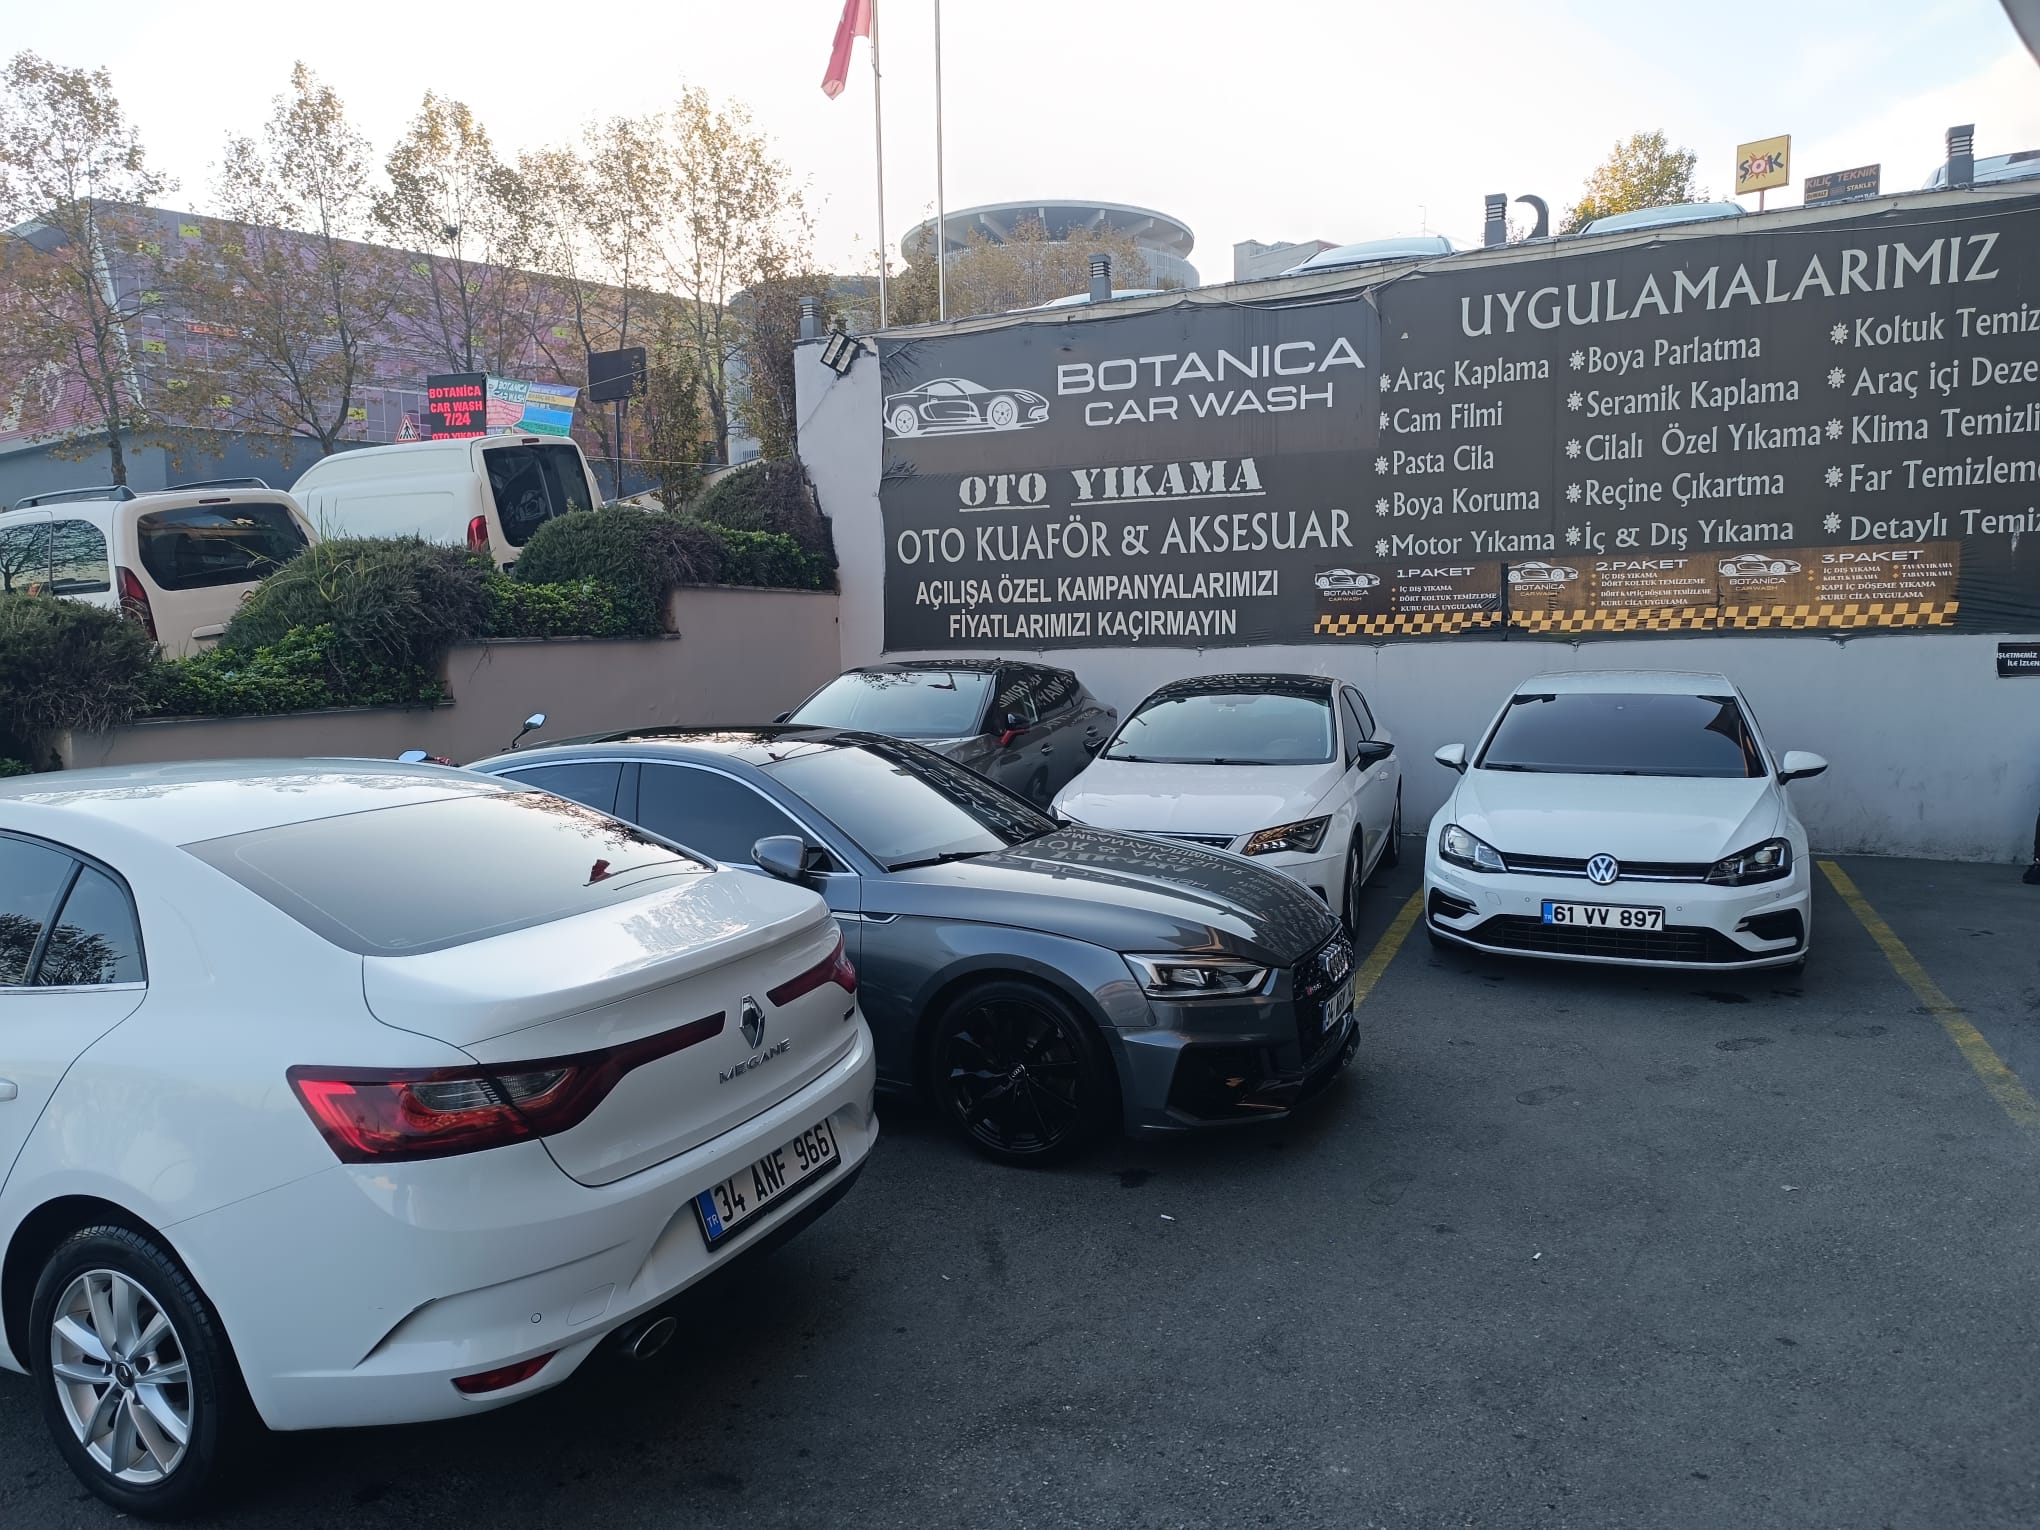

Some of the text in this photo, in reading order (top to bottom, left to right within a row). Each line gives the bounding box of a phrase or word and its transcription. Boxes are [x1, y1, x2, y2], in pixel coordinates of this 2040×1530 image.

[1846, 181, 1876, 192] STANLEY
[1460, 232, 2000, 337] UYGULAMALARIMIZ
[1854, 311, 1945, 347] Koltuk
[1057, 337, 1366, 395] BOTANICA
[1588, 336, 1760, 375] Boya Parlatma
[429, 384, 482, 399] BOTANİCA
[1393, 357, 1549, 395] Araç Kaplama
[1851, 356, 2039, 399] Araç içi Deze
[430, 400, 483, 413] CAR WASH
[1085, 382, 1333, 426] CAR WASH
[1586, 378, 1799, 417] Seramik Kaplama
[443, 412, 471, 426] 7/24
[1393, 400, 1503, 433] Cam Filmi
[1851, 414, 1928, 445] Klima
[1585, 422, 1821, 461] Cilalı Özel Yıkama
[1393, 445, 1494, 475] Pasta Cila
[1850, 455, 2040, 492] Far Temizlem
[959, 458, 1262, 507] OTO YIKAMA
[1585, 472, 1784, 510] Reçine Çıkartma
[1393, 487, 1539, 520] Boya Koruma
[898, 509, 1353, 565] OTO KUAFÖR & AKSESUAR
[1391, 530, 1555, 557] Motor Yıkama
[1584, 519, 1793, 555] İç & Dış Yıkama
[1850, 511, 1948, 543] Detaylı
[1596, 559, 1688, 571] 2.PAKET
[1821, 550, 1924, 564] 3.PAKET
[915, 570, 1278, 610] AÇILIŞA ÖZEL KAMPANYALARIMIZI
[1453, 592, 1497, 600] TEMİZLEME
[1820, 593, 1847, 601] KURU
[1872, 591, 1924, 599] UYGULAMA
[1857, 582, 1897, 590] DÖŞEME
[1899, 580, 1936, 588] YIKAMA
[1441, 603, 1482, 611] UYGULAMA
[1644, 598, 1688, 606] UYGULAMA
[949, 608, 1236, 641] FİYATLARIMIZI KAÇIRMAYIN
[1553, 906, 1574, 923] 61
[1584, 907, 1610, 925] VV
[1620, 910, 1661, 928] 897
[719, 1038, 791, 1084] MEGANE
[707, 1123, 831, 1228] TR 34 ANF 966
